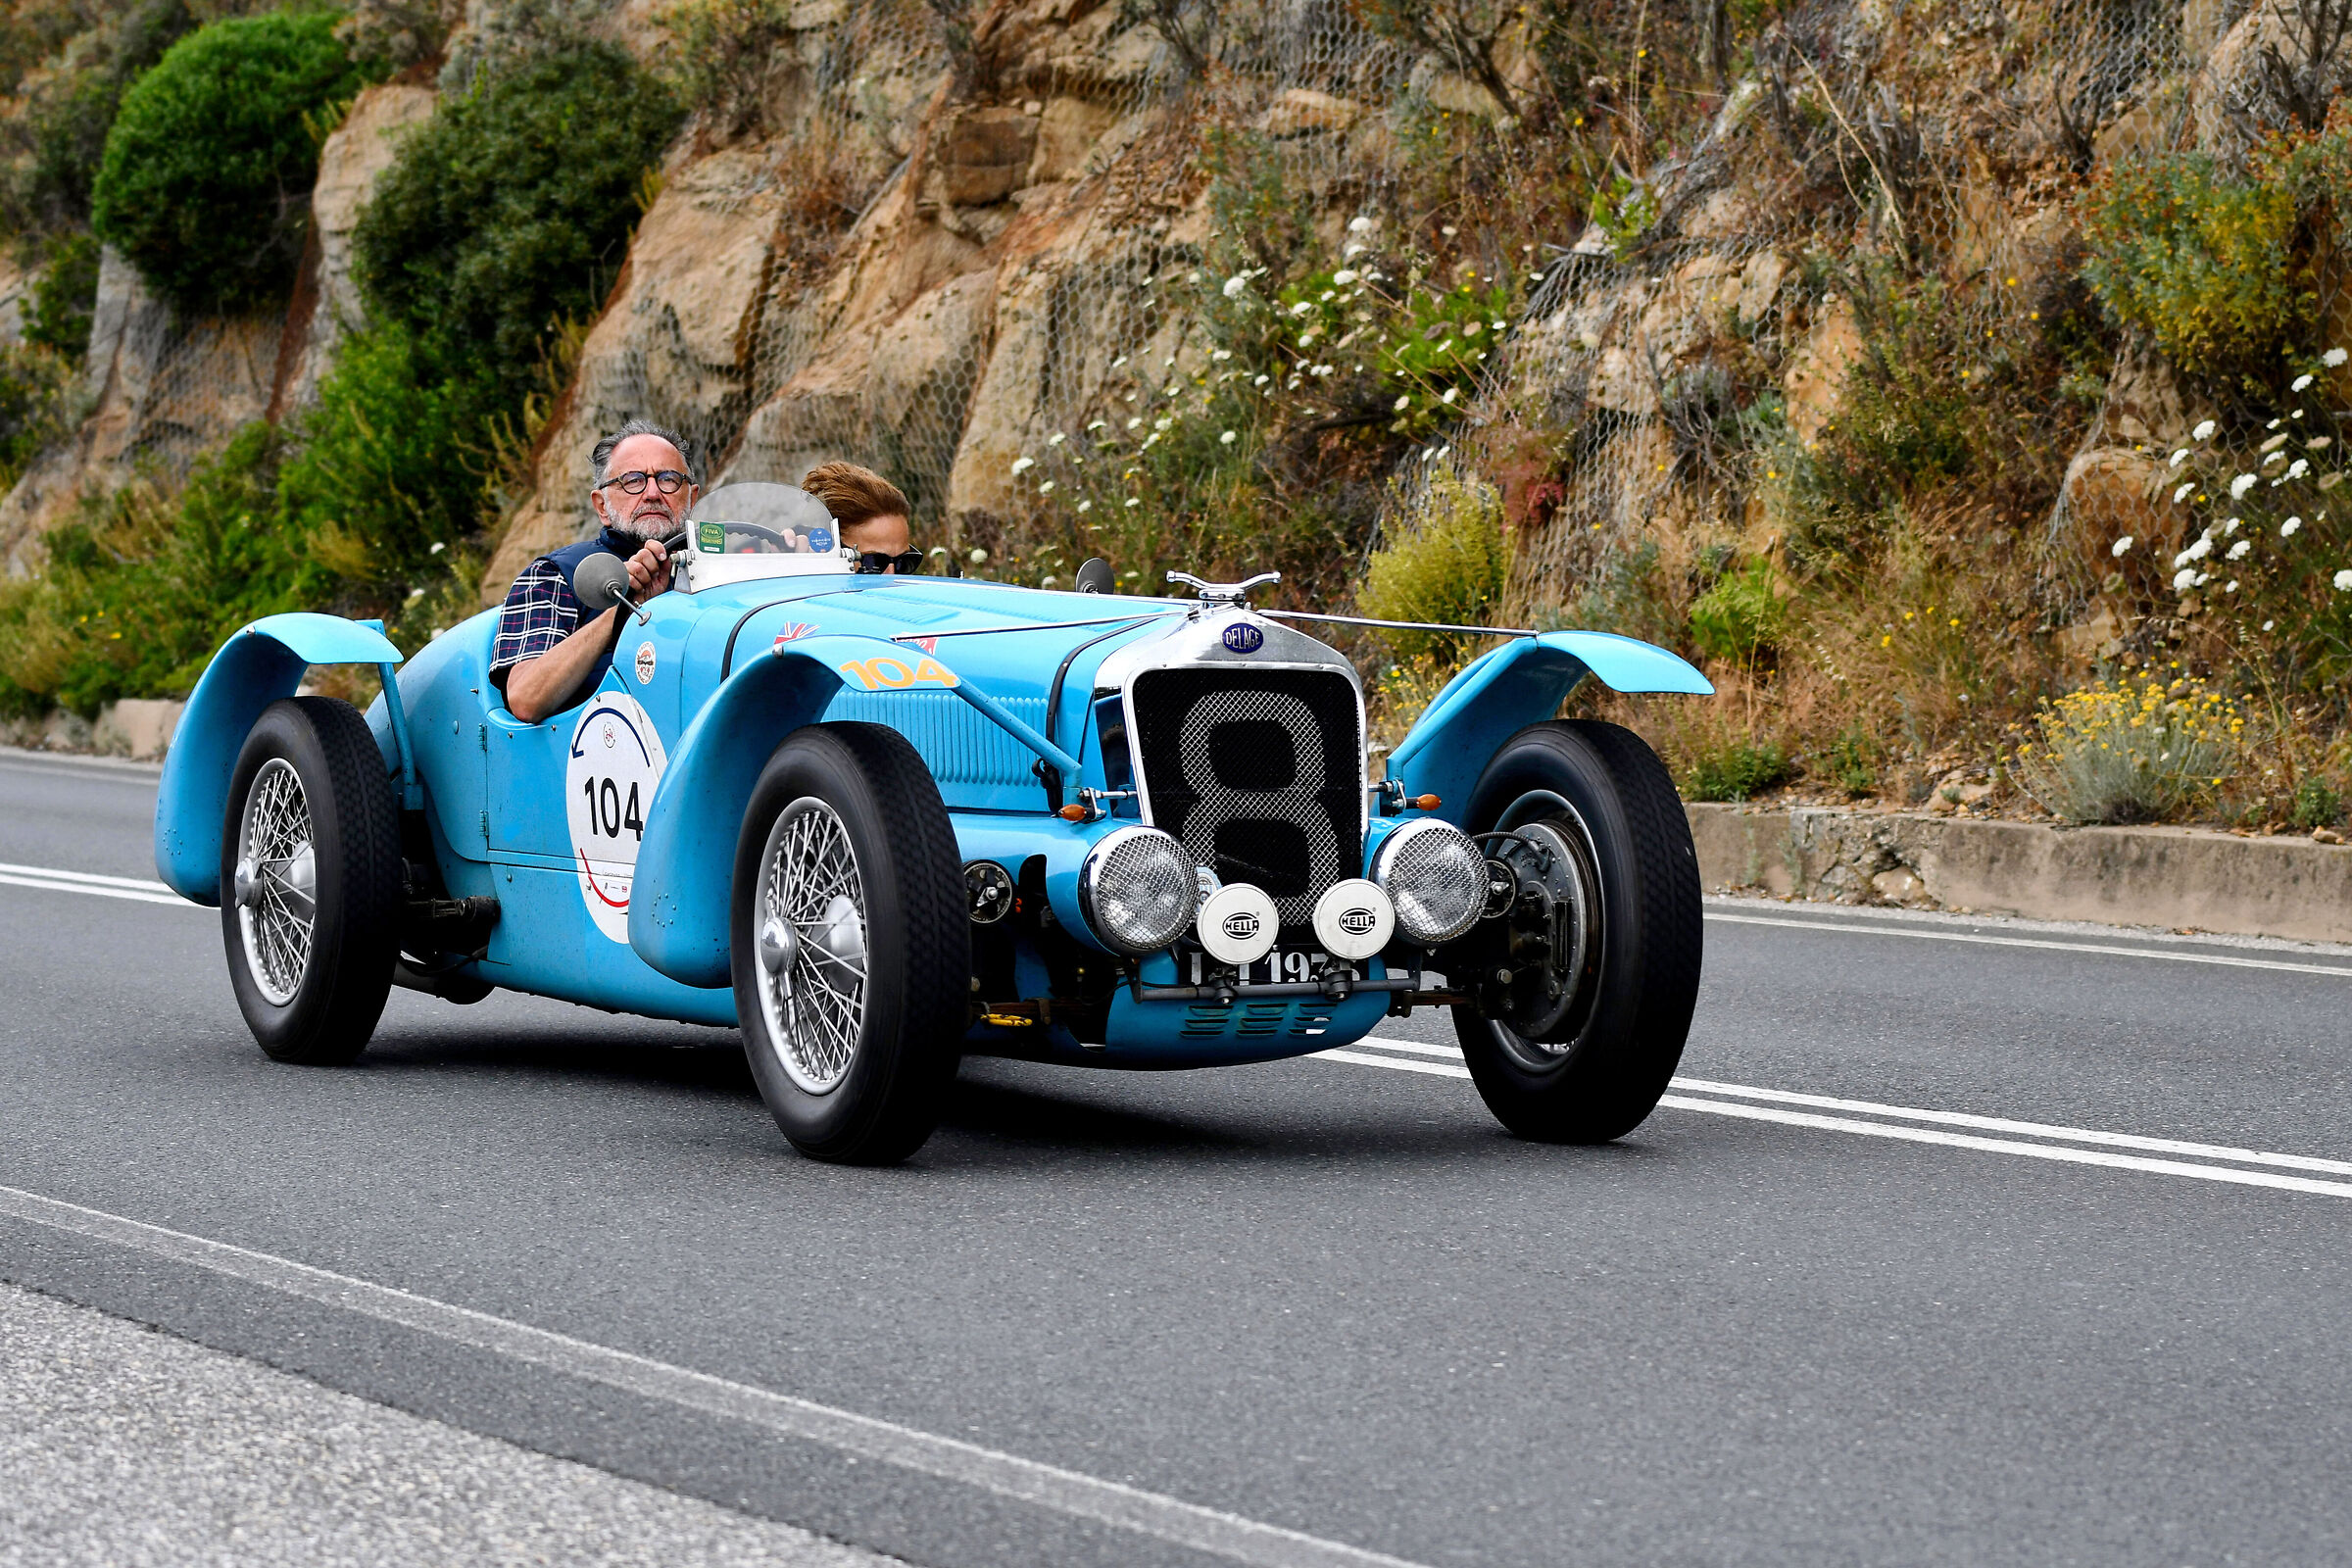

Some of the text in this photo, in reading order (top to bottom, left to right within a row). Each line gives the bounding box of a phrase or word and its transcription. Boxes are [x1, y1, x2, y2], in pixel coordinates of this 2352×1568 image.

[1225, 627, 1260, 650] DELAGE
[839, 660, 958, 690] 104
[584, 775, 644, 842] 104
[1179, 690, 1340, 926] 8
[1225, 919, 1260, 931] HELLA
[1342, 915, 1376, 927] HELLA
